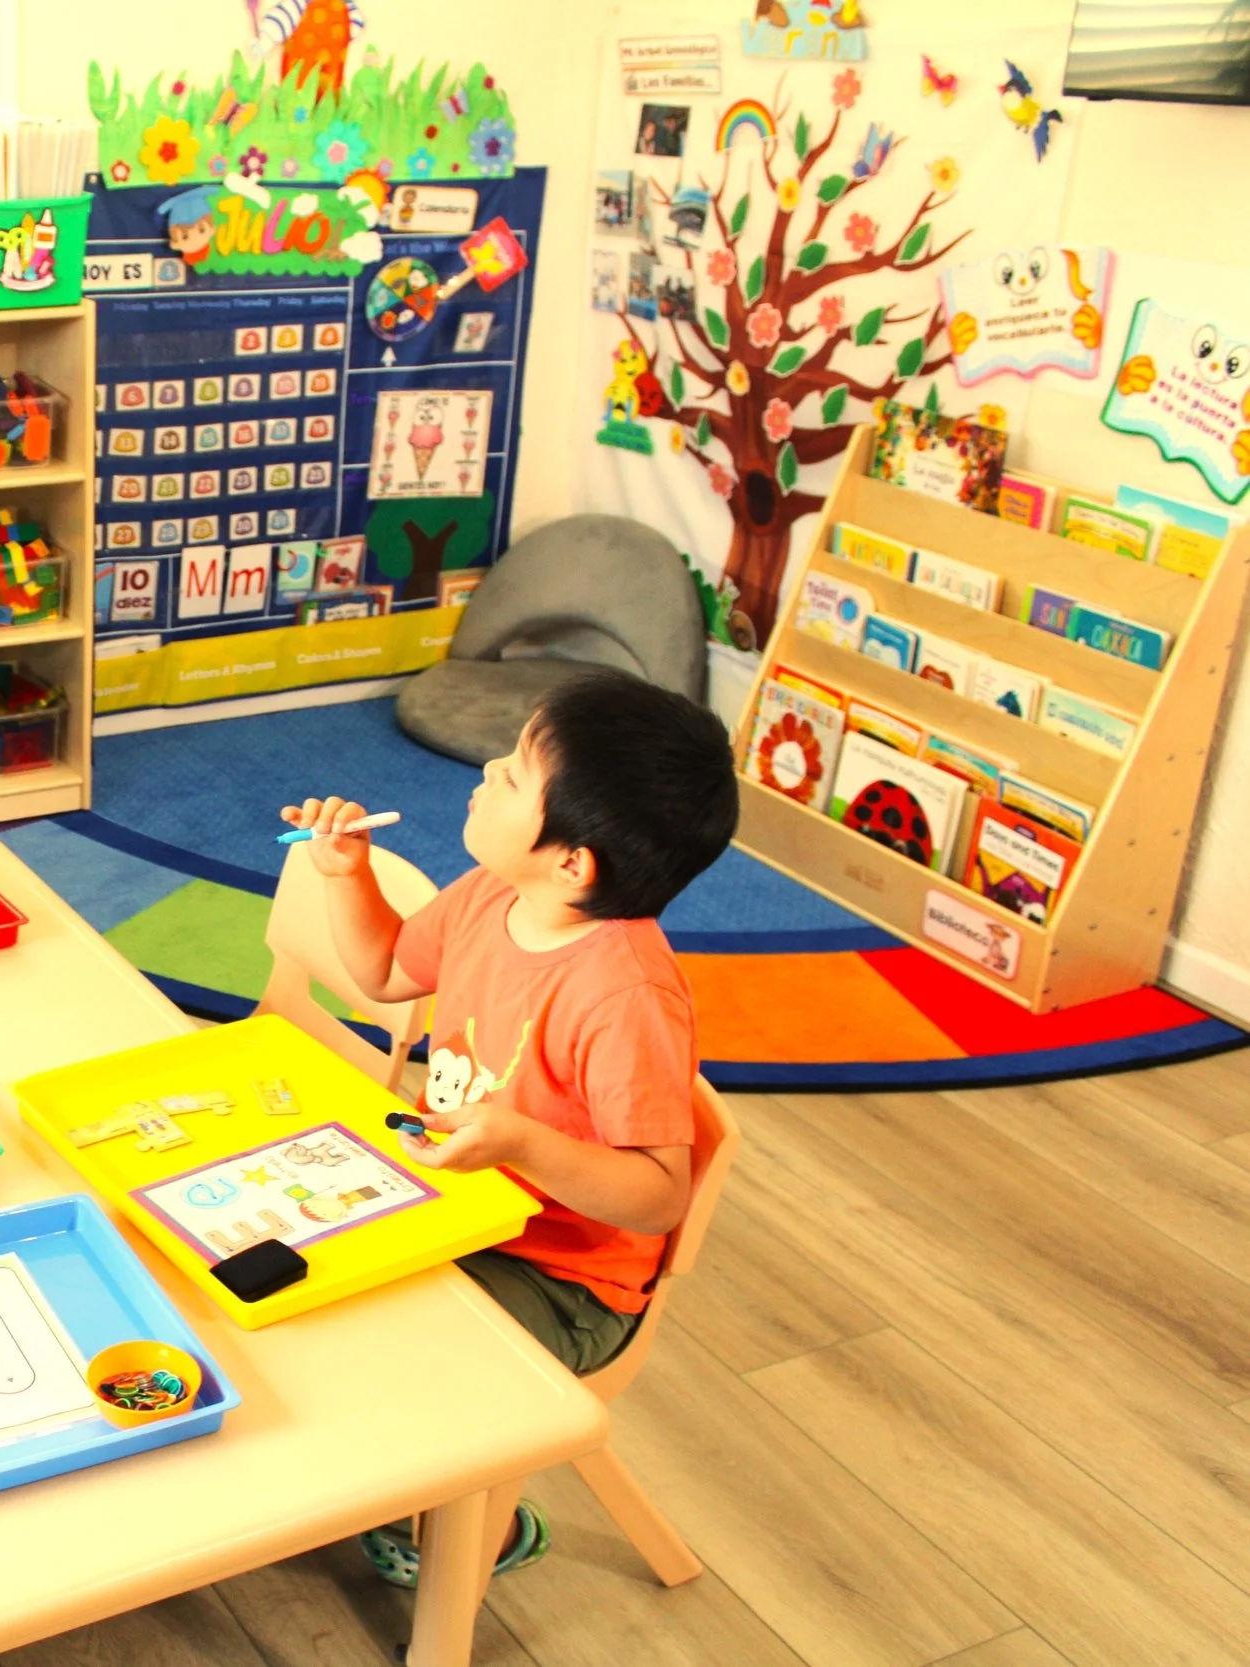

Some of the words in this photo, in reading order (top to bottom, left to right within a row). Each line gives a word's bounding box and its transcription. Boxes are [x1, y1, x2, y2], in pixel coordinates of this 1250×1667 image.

[124, 263, 142, 280] ES
[1010, 296, 1039, 308] Leer
[984, 311, 1049, 327] enriquece
[1171, 366, 1187, 381] La
[1191, 377, 1239, 409] lectura
[121, 568, 150, 591] 10
[186, 559, 218, 598] M
[230, 566, 266, 598] m
[115, 596, 154, 610] diez
[93, 681, 140, 698] alendar
[179, 667, 220, 681] Letters
[927, 907, 991, 948] Biblioteca
